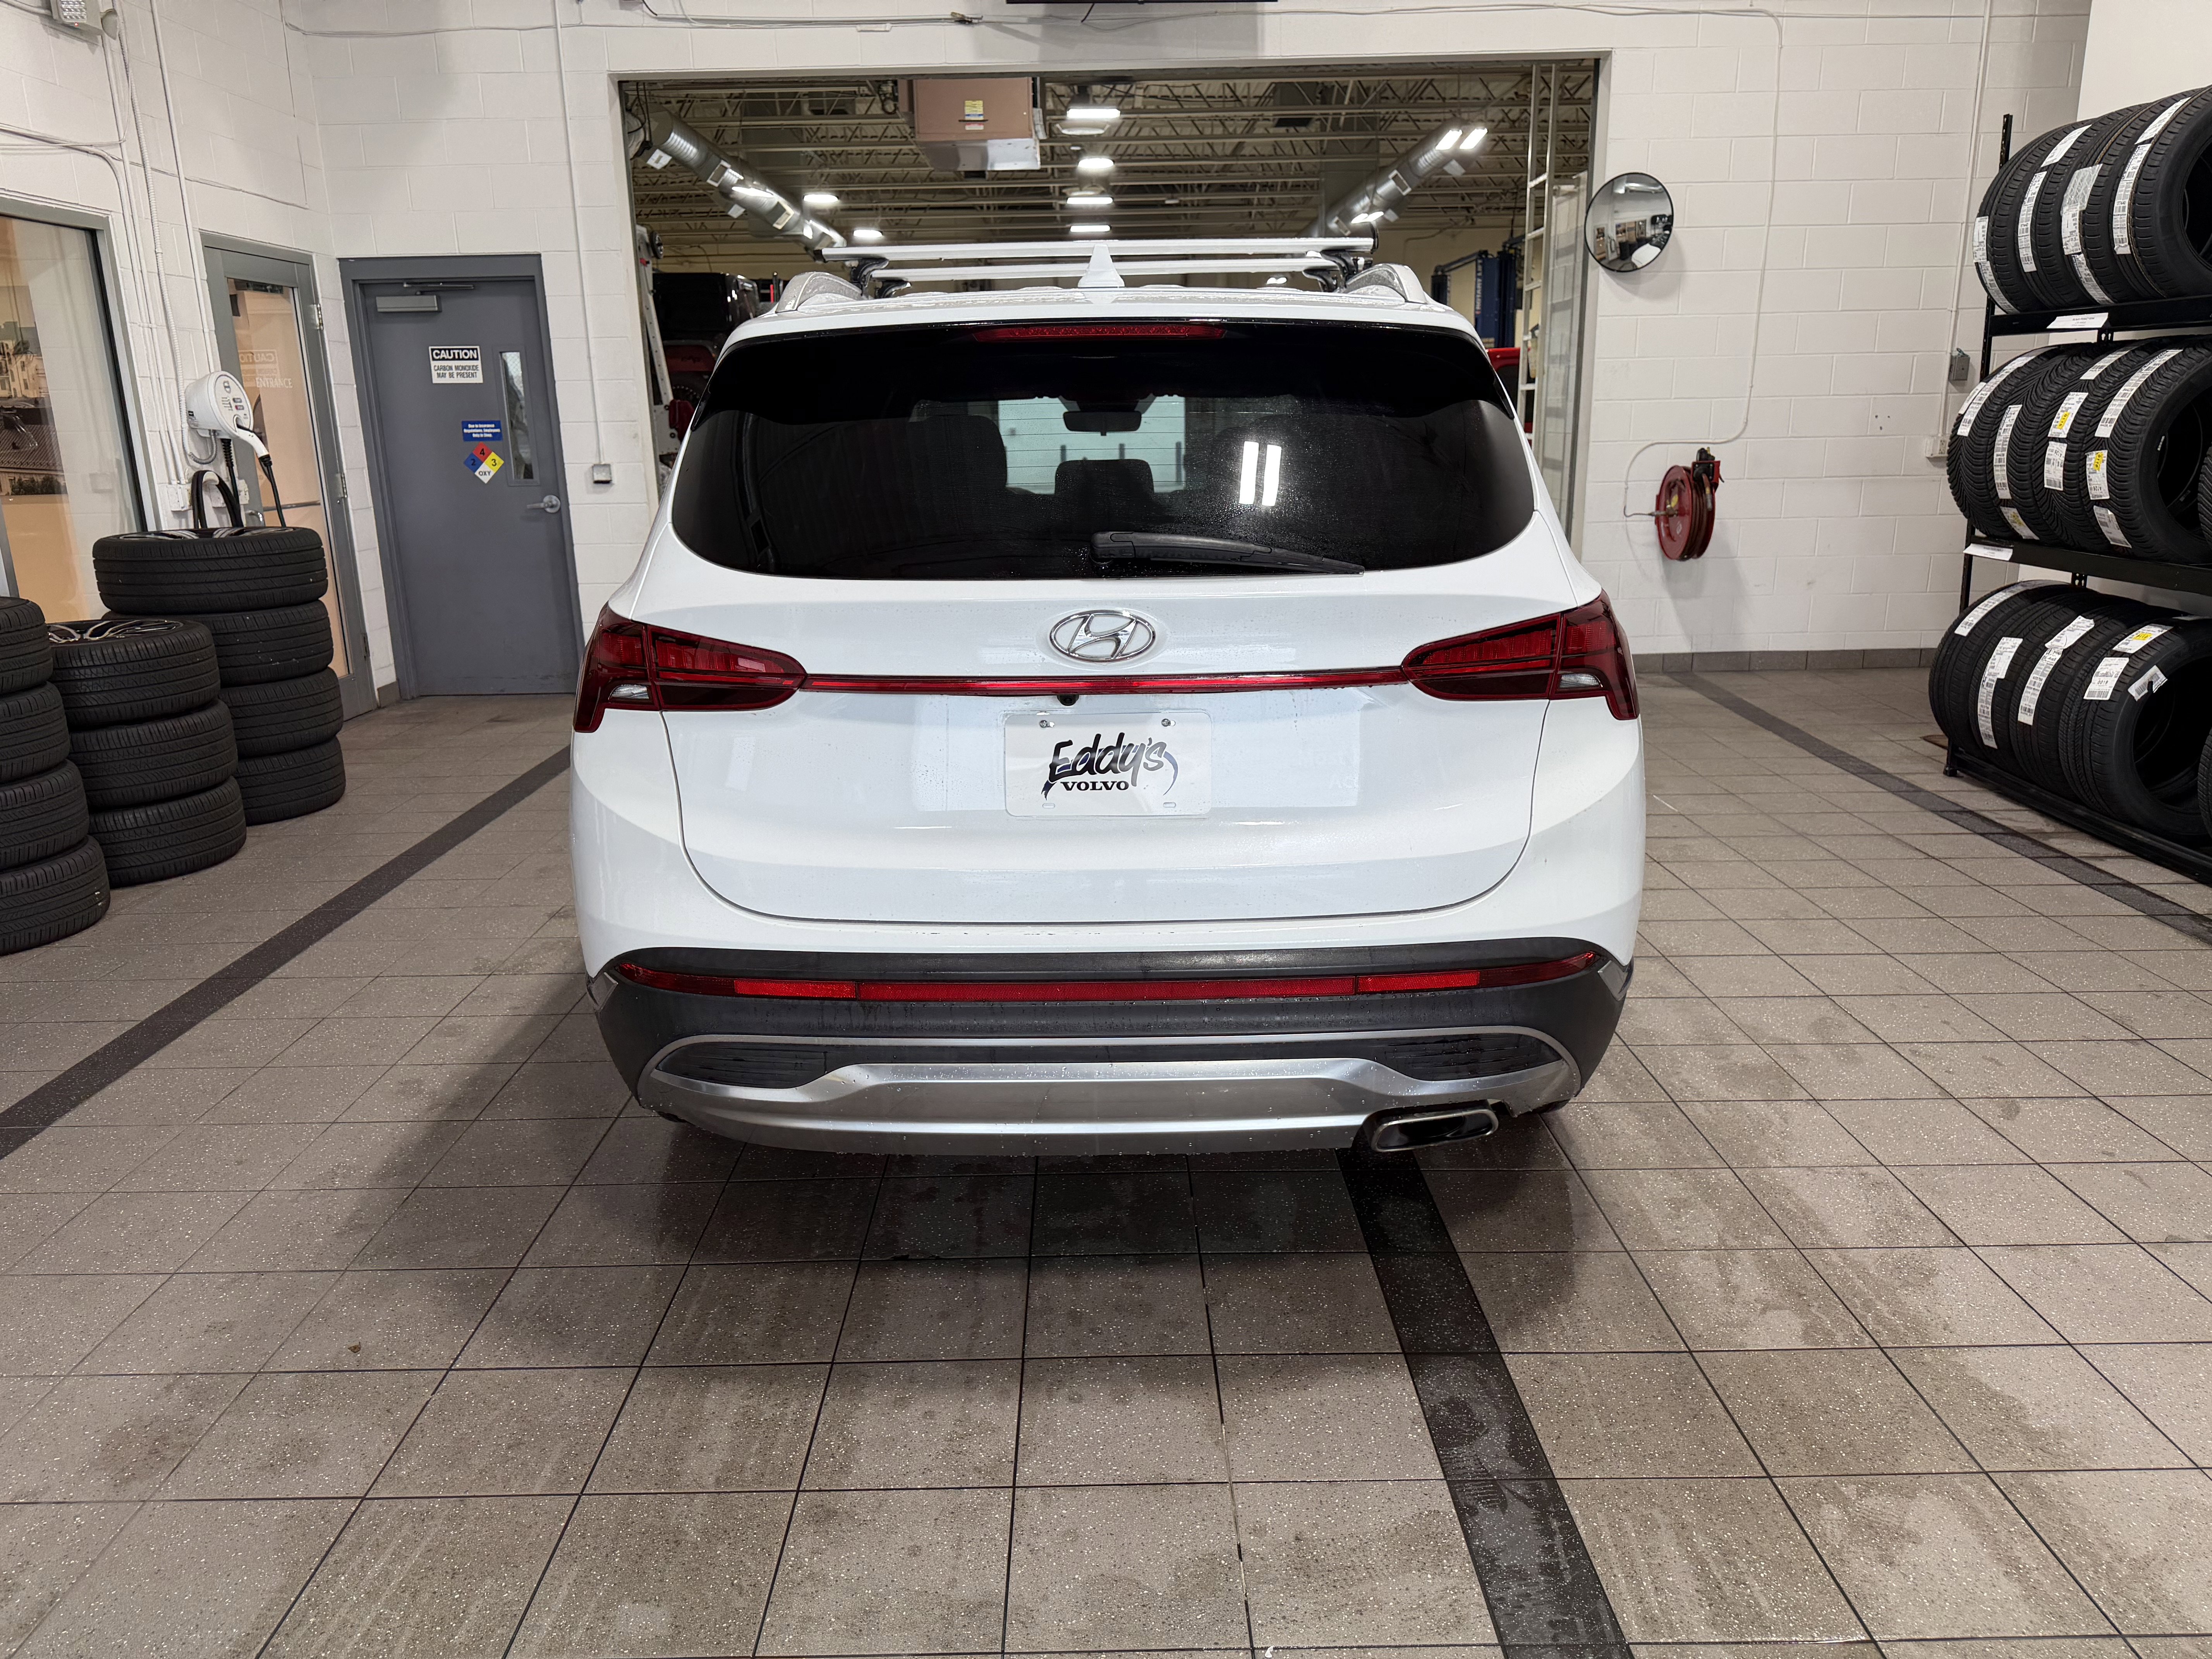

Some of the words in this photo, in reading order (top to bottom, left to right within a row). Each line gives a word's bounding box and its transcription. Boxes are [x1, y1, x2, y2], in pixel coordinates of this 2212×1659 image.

[433, 349, 477, 359] CAUTION
[255, 377, 293, 388] ENTRANCE
[479, 448, 486, 456] 4
[491, 459, 497, 467] 3
[1048, 732, 1167, 787] Eddy's
[1060, 780, 1129, 791] VOLVO
